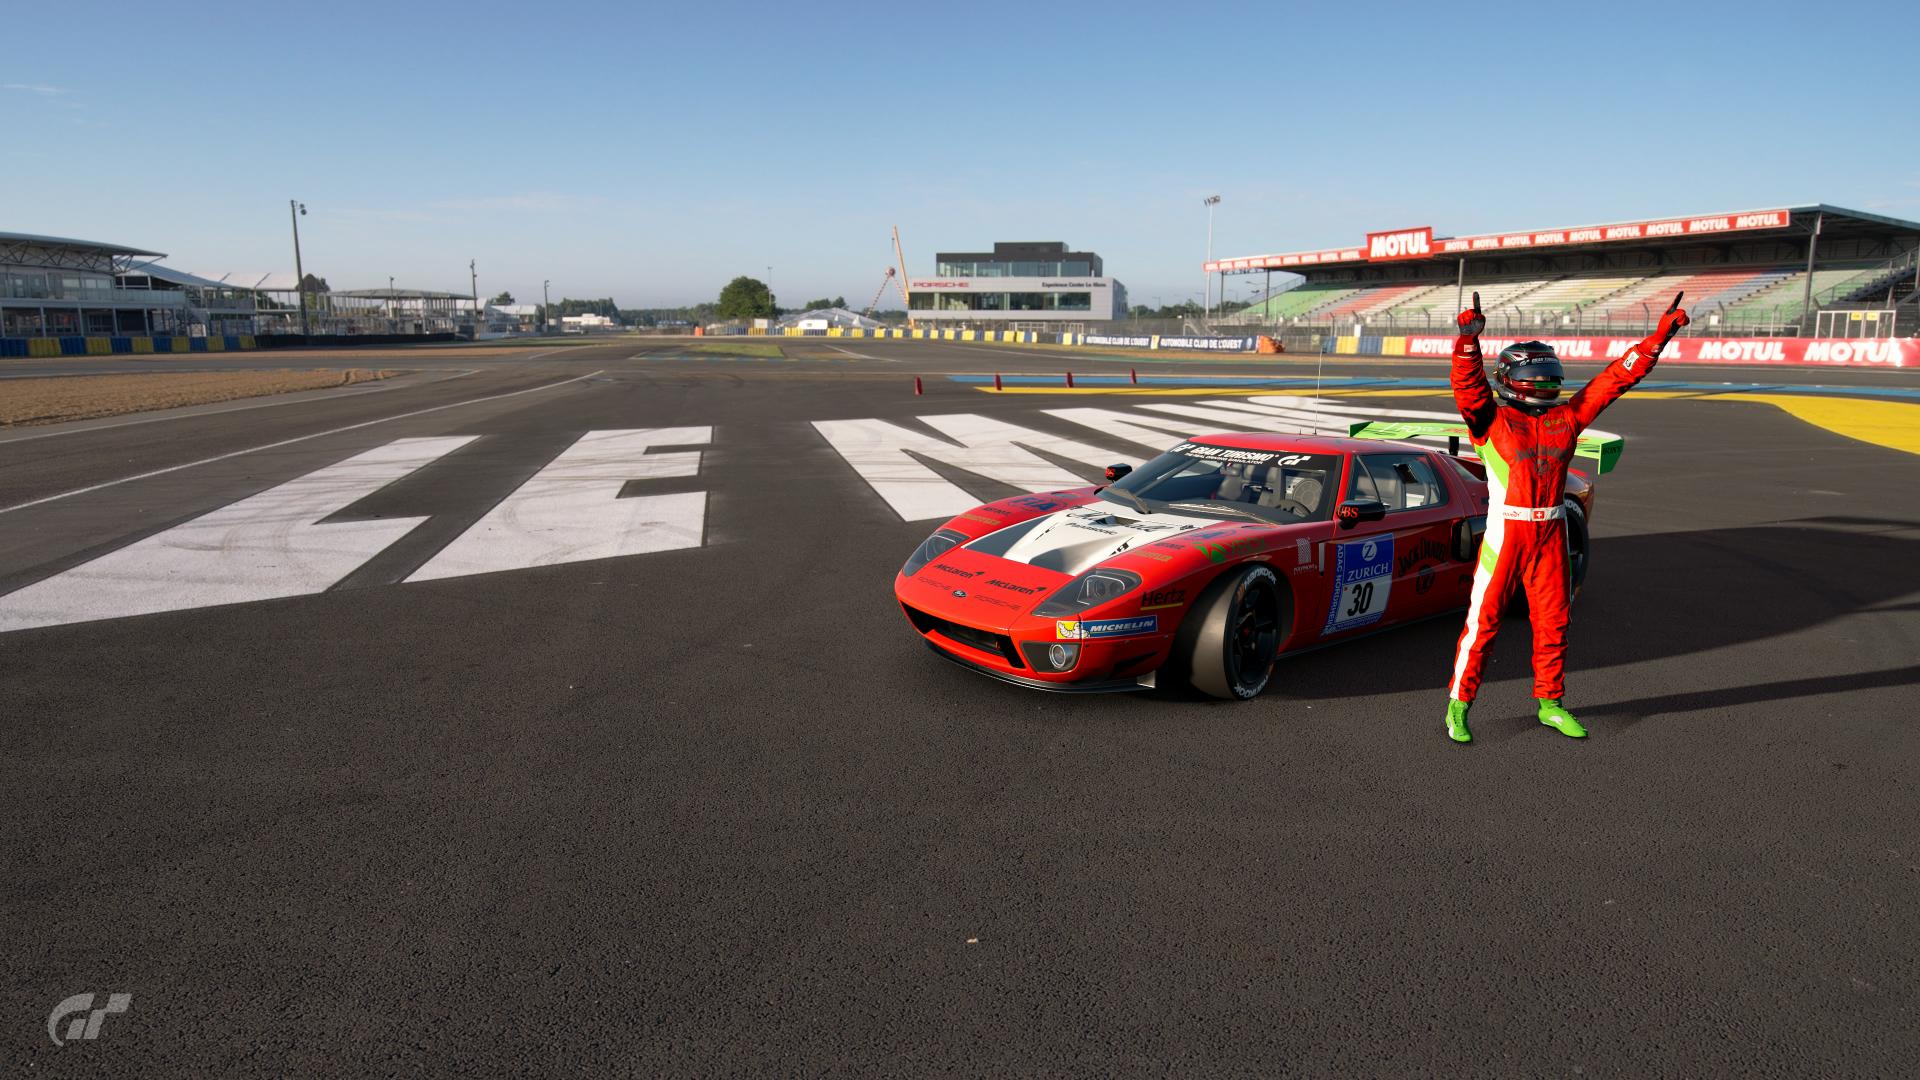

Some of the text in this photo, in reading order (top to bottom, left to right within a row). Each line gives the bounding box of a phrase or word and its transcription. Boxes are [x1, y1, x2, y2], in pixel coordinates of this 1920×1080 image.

[1689, 218, 1729, 232] MOTUL
[1736, 213, 1780, 228] MOTUL
[1569, 230, 1601, 242] MOTUL
[1606, 226, 1641, 239] MOTUL
[1646, 222, 1683, 236] MOTUL
[1371, 231, 1430, 258] MOTUL
[1473, 237, 1499, 249] MOTUL
[1503, 235, 1531, 247] MOTUL
[1534, 232, 1565, 245] MOTUL
[1160, 336, 1193, 348] AUTOMOBILE
[1193, 337, 1208, 348] CLUB
[1209, 338, 1218, 348] DE
[1698, 341, 1785, 361] MOTUL
[1803, 341, 1903, 362] MOTUL
[1190, 446, 1221, 458] GRAN
[1220, 449, 1275, 462] TURISMO
[1337, 506, 1359, 519] UBS
[0, 426, 713, 634] LE
[1336, 544, 1344, 572] ADAC
[934, 564, 974, 579] McLaren
[1347, 562, 1389, 582] ZURICH
[985, 579, 1035, 596] McLaren
[1141, 588, 1185, 608] Hertz
[1347, 581, 1374, 617] 30
[1089, 619, 1155, 633] MICHELIN
